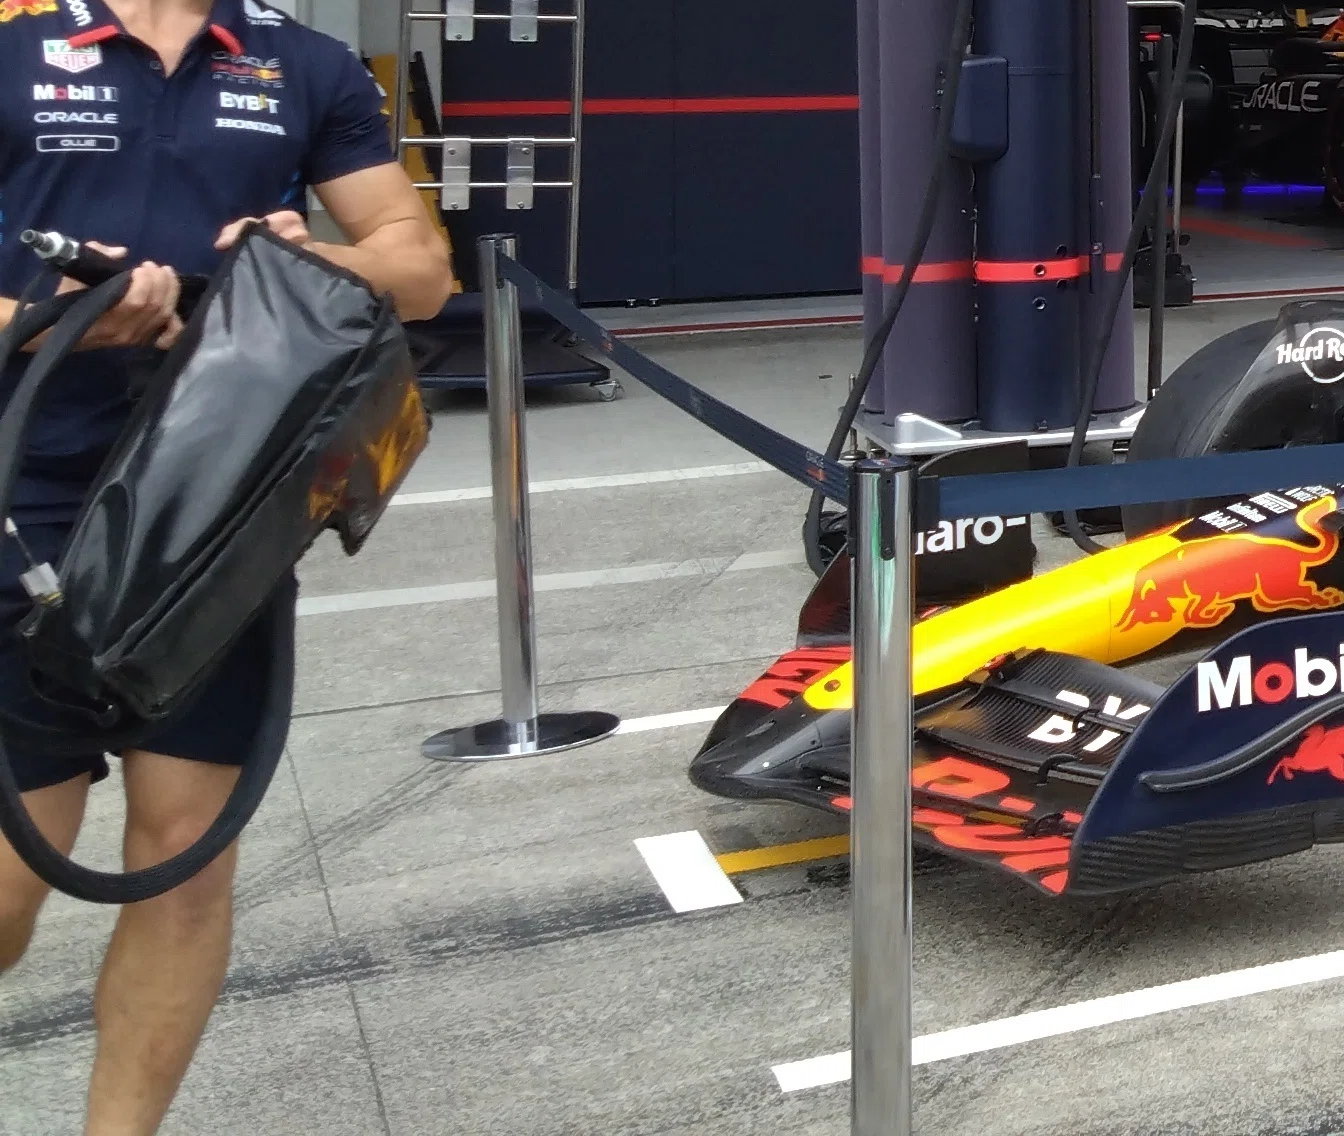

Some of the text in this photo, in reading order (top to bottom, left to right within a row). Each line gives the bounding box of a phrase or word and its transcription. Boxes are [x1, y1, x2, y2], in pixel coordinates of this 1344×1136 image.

[35, 84, 96, 101] Mobil
[220, 92, 280, 113] BYBIT
[35, 111, 120, 124] ORACLE
[216, 118, 287, 135] HONDA
[60, 137, 97, 147] OLLIE
[1276, 339, 1323, 365] Hard
